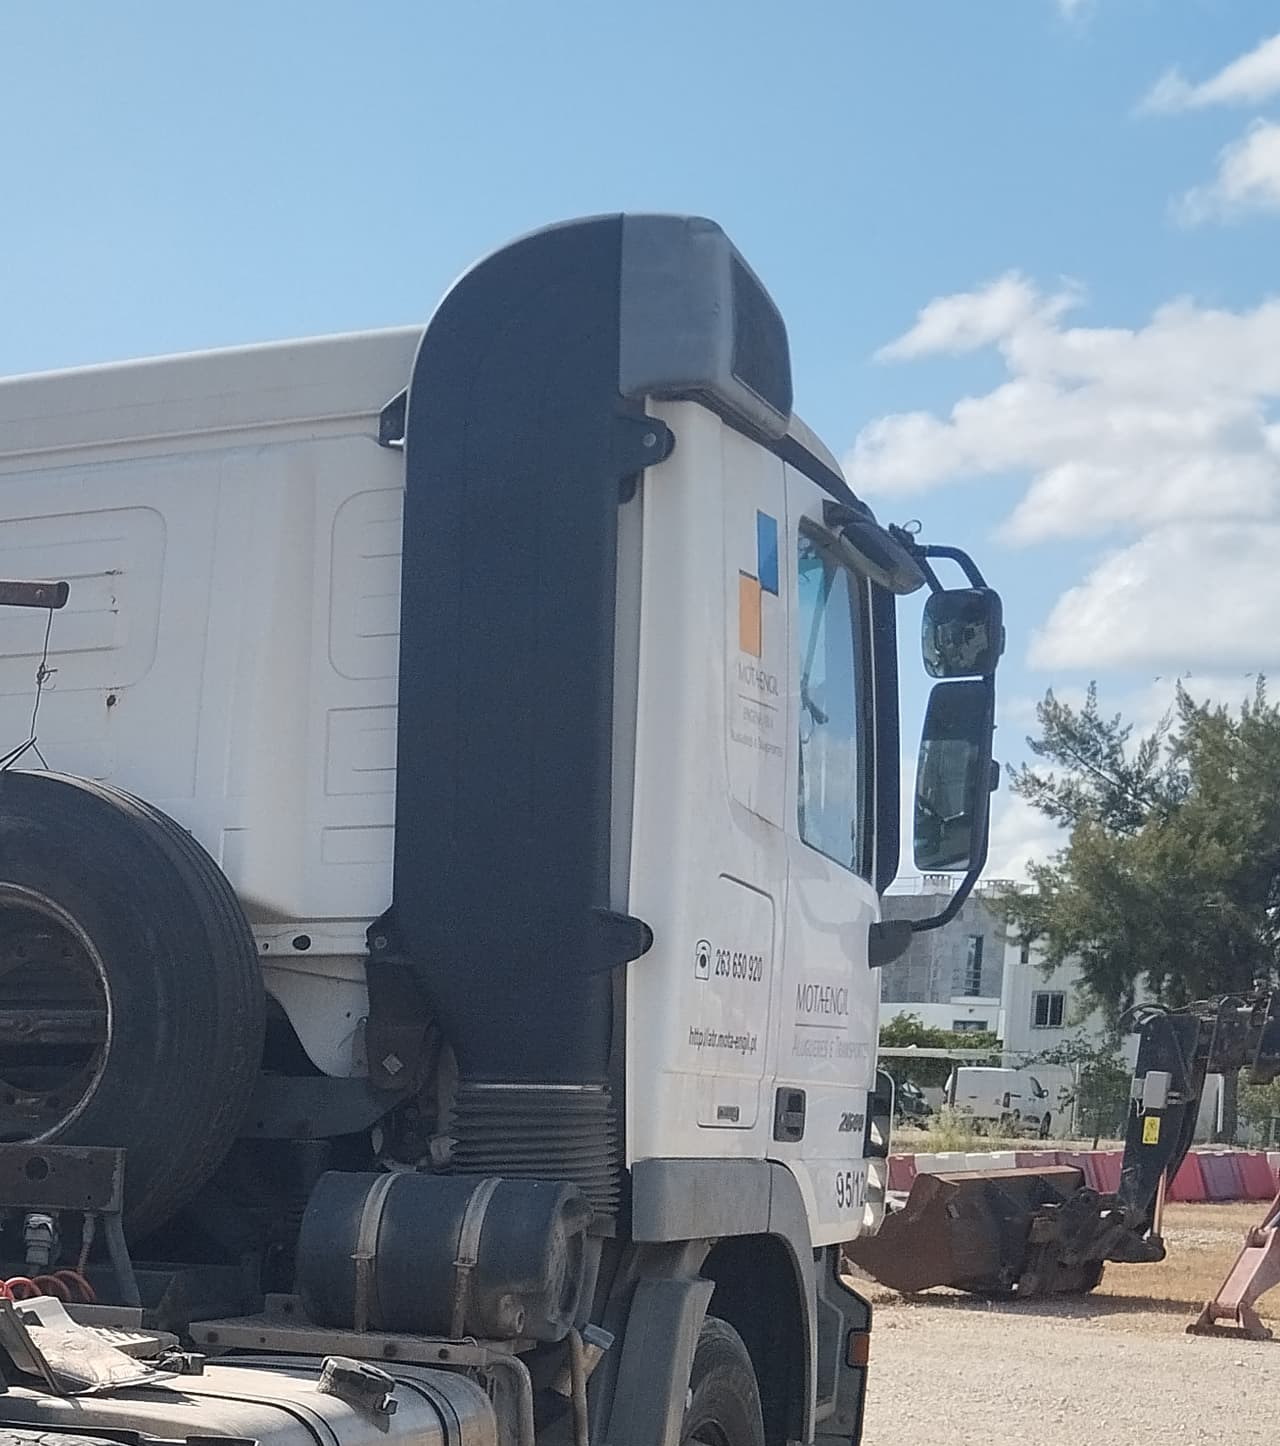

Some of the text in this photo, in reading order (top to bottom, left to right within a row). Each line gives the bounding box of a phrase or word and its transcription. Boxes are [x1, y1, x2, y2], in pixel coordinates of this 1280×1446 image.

[715, 948, 762, 982] 263 650 920
